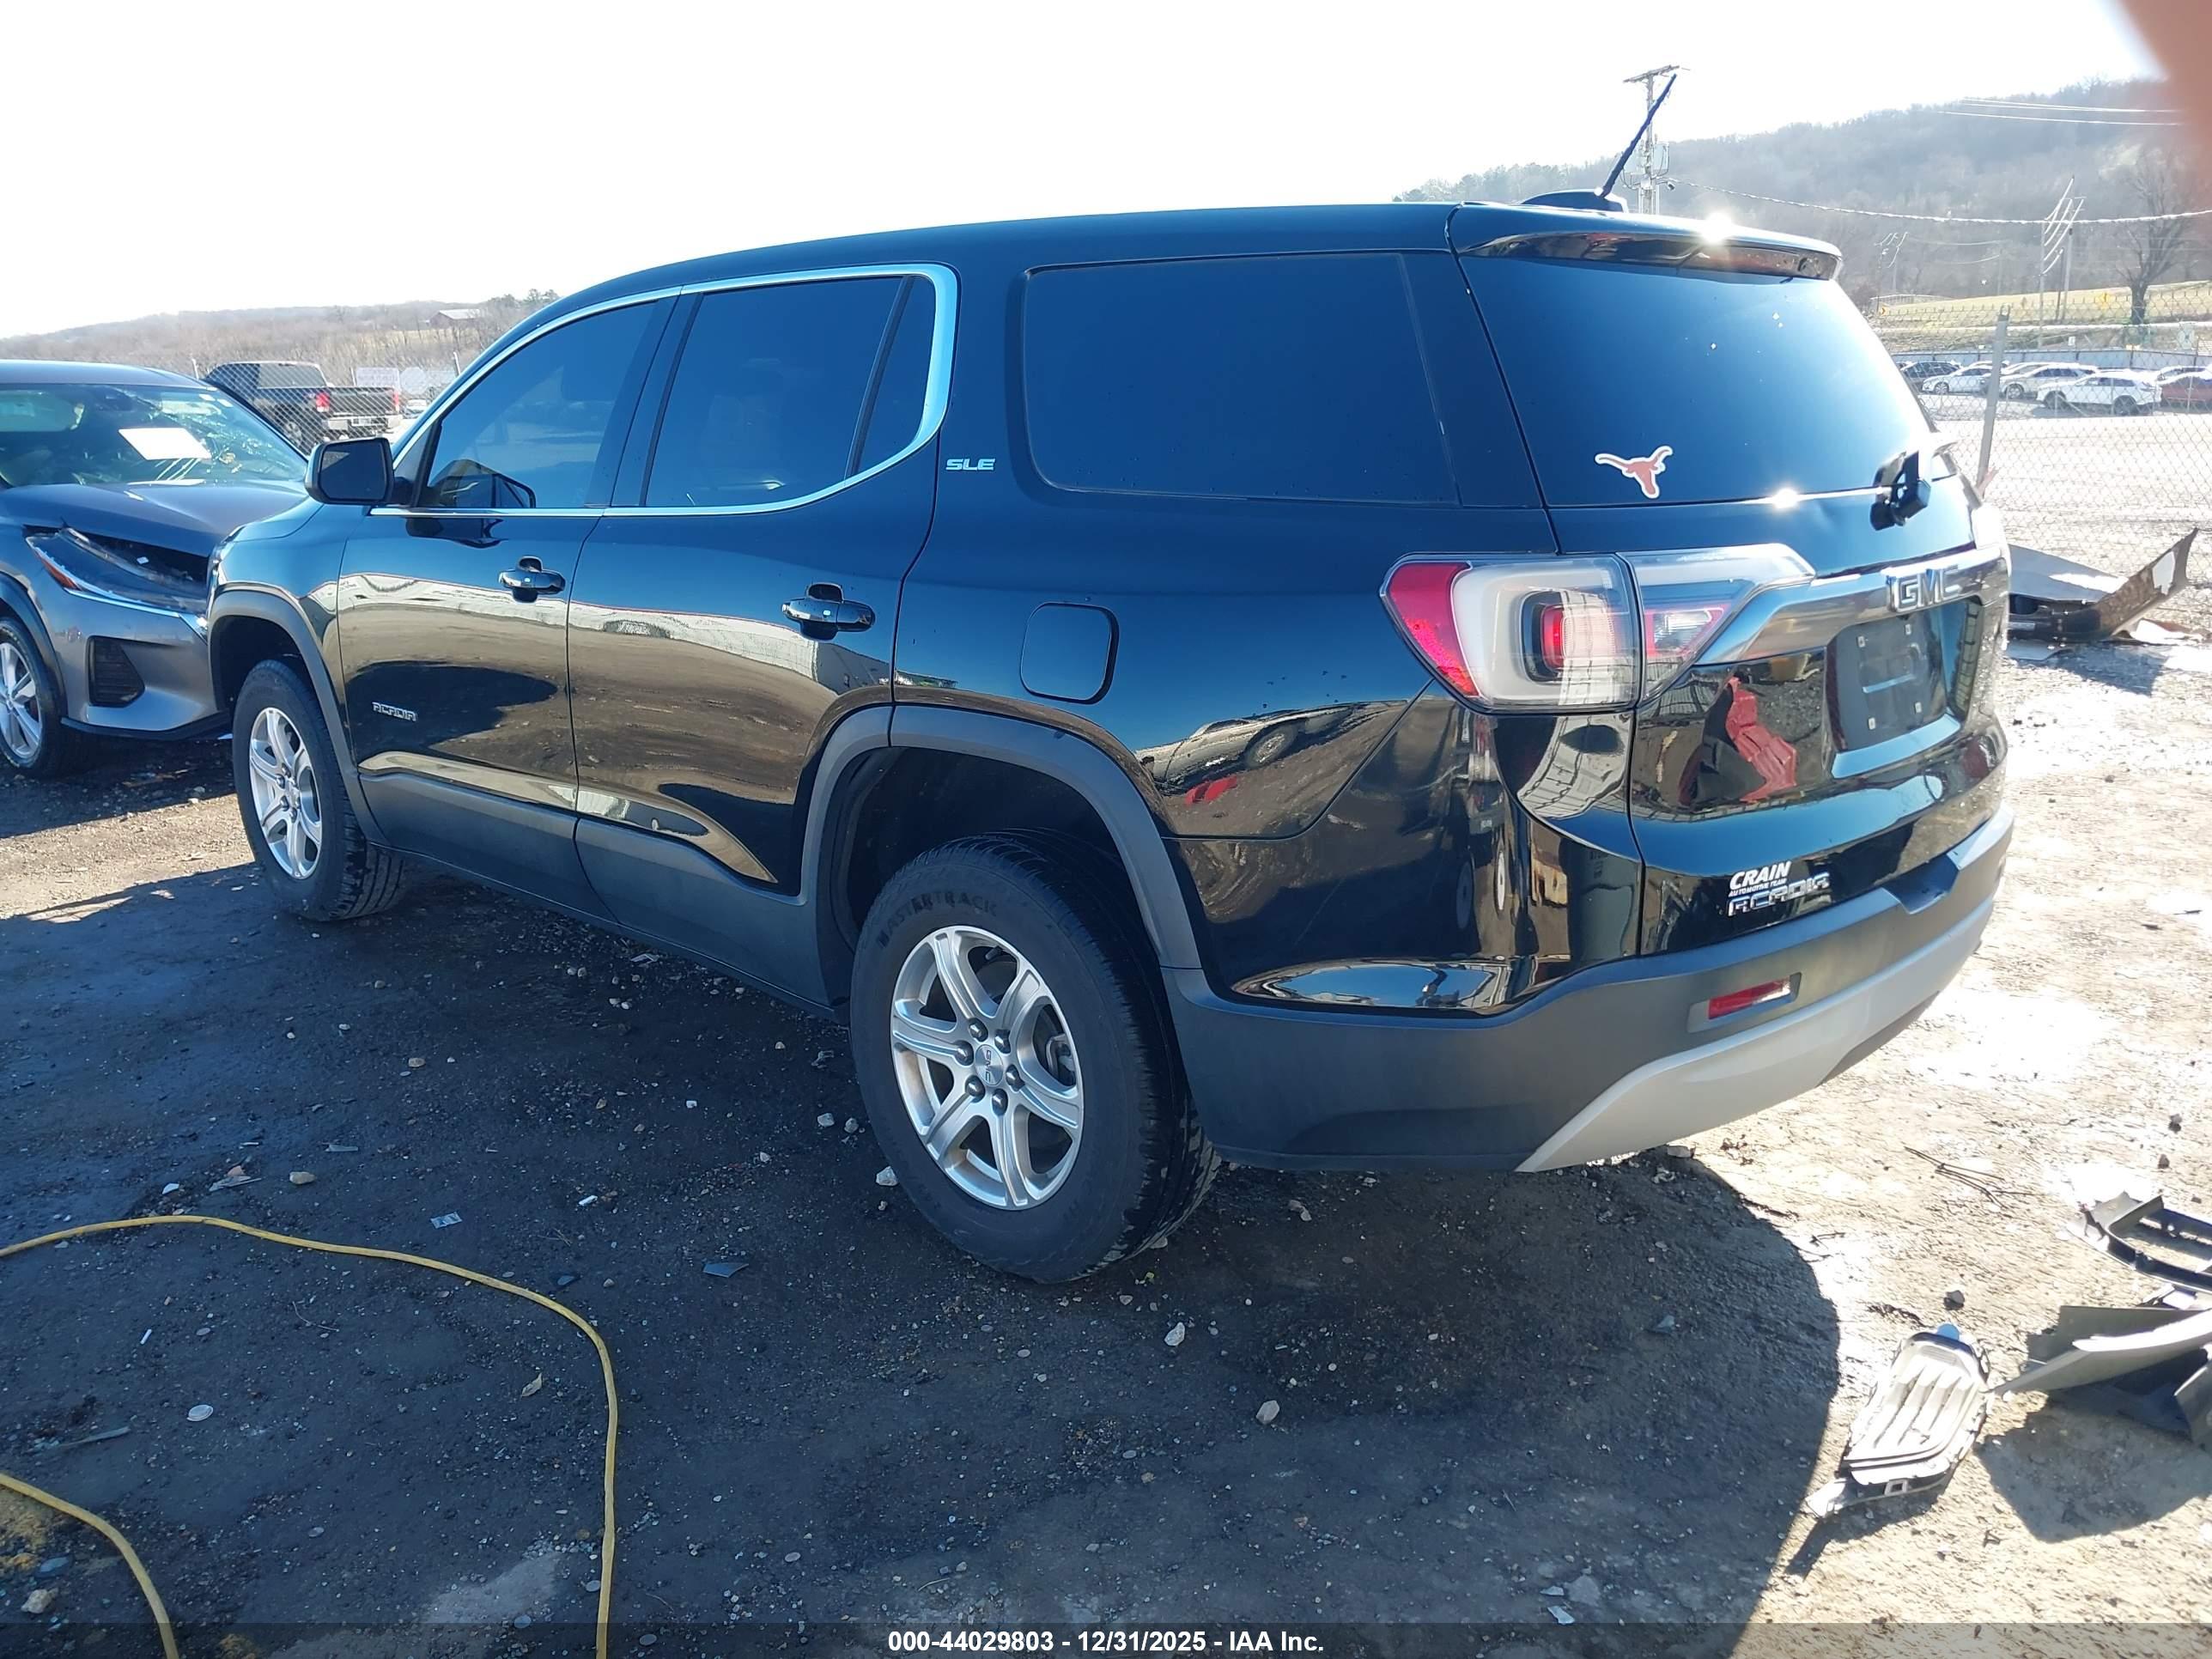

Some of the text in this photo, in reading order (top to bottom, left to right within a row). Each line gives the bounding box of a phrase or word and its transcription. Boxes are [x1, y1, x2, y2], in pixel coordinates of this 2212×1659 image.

[945, 458, 996, 471] SLE
[1887, 567, 1965, 612] GMC
[1729, 860, 1792, 890] CRAIN
[1728, 872, 1830, 916] ACADIA
